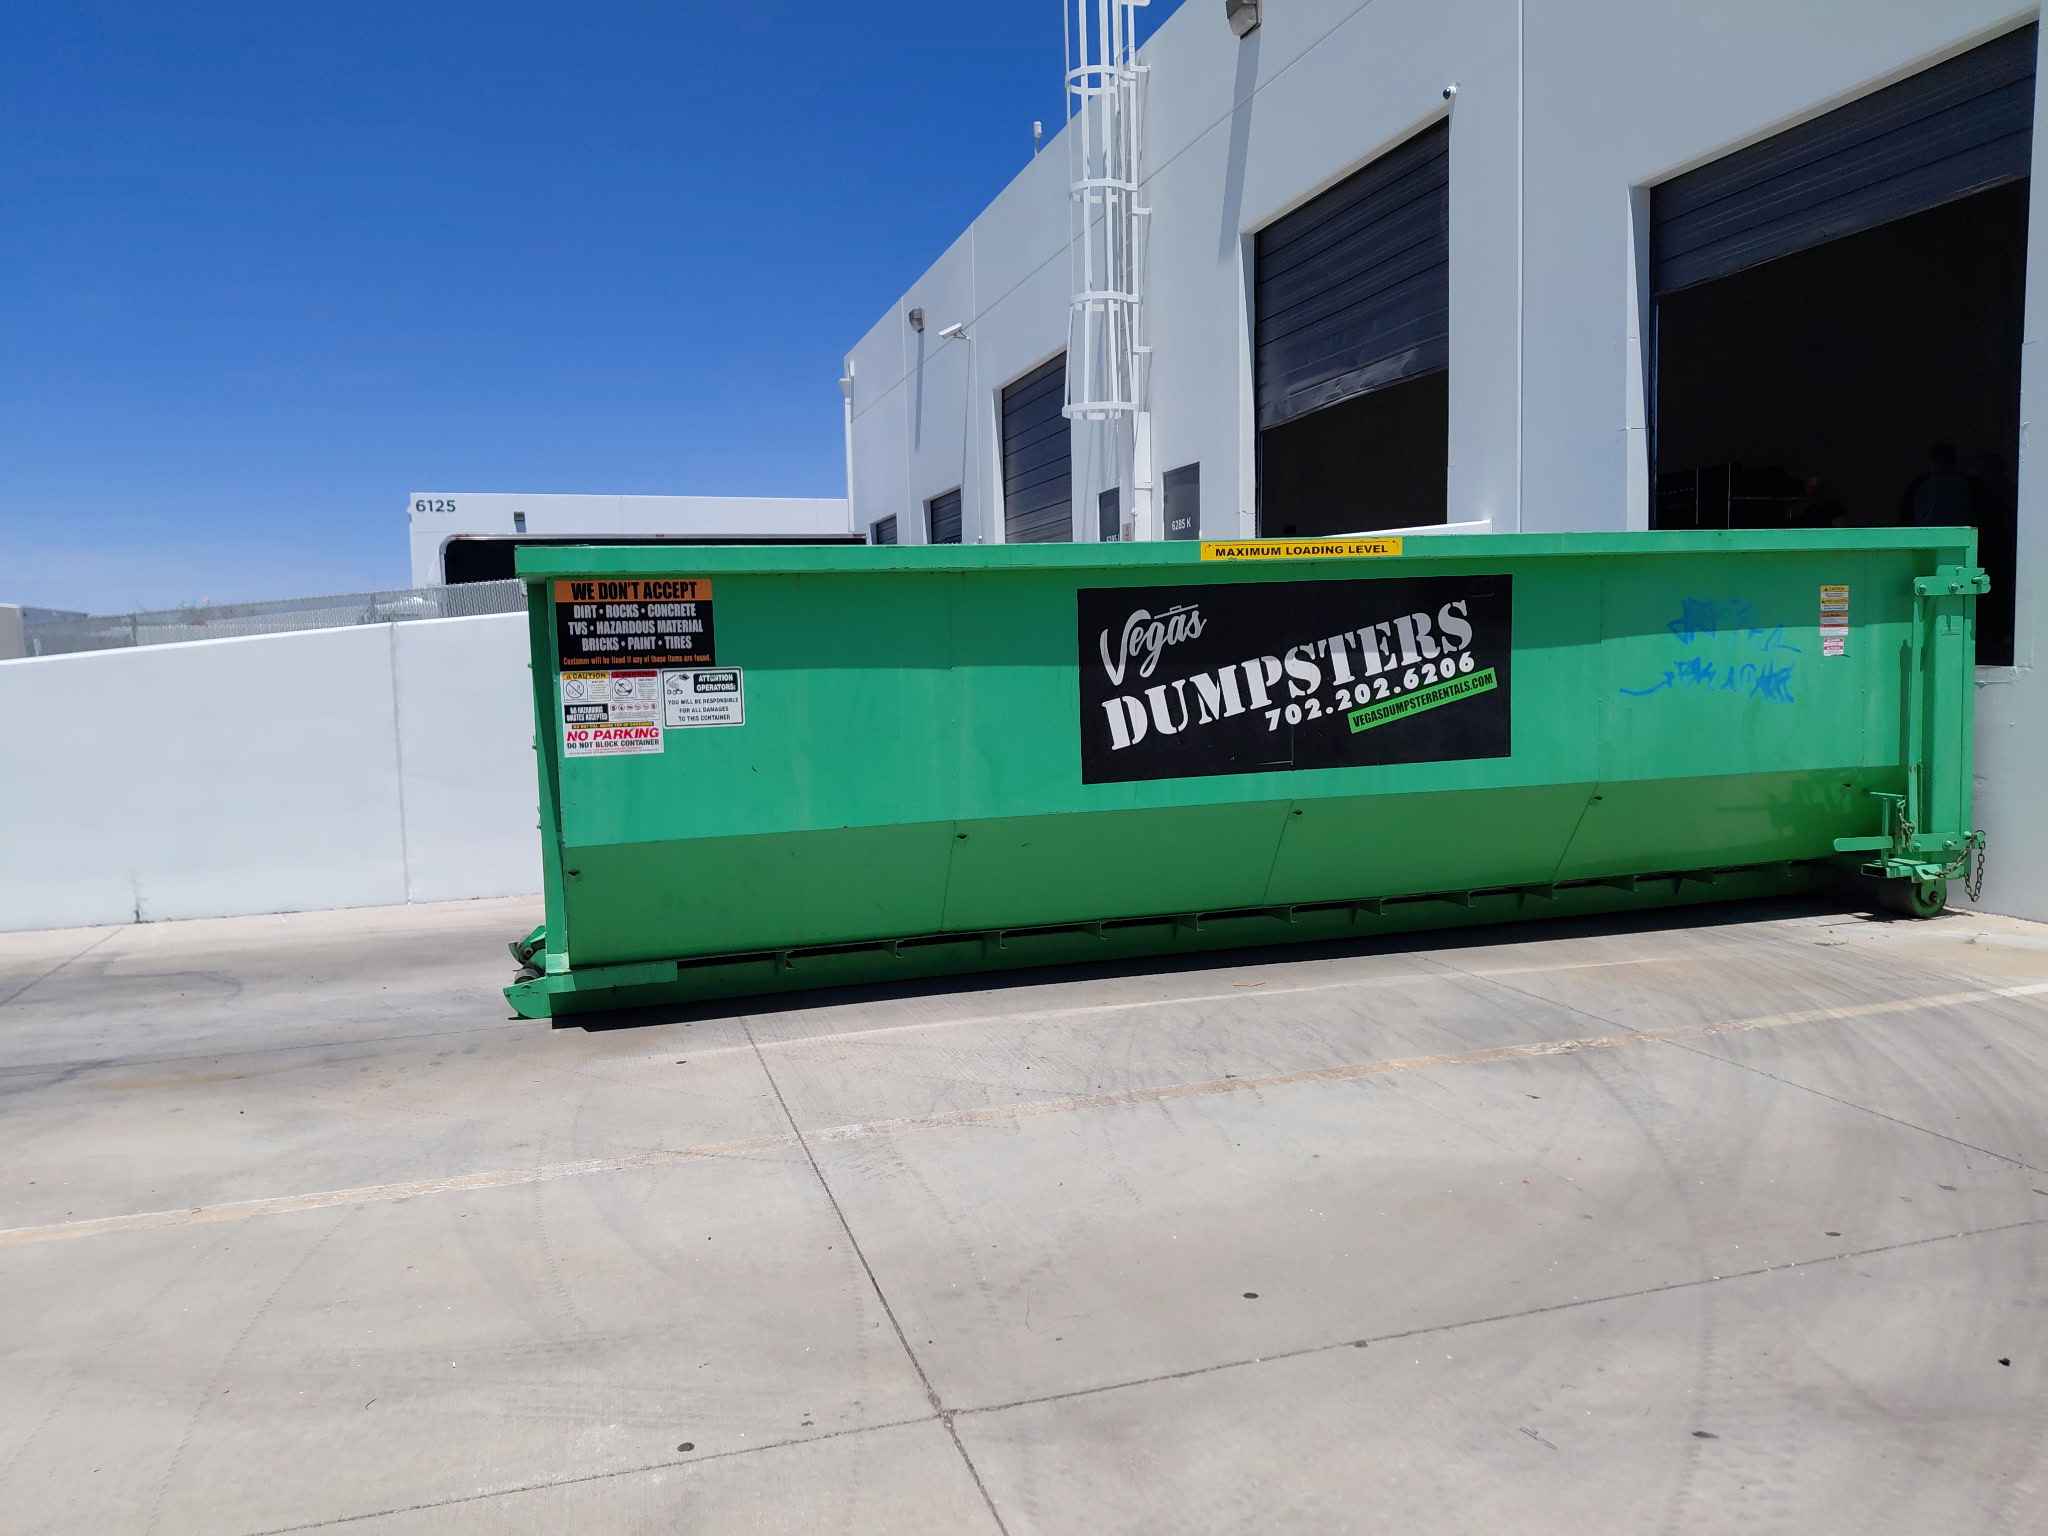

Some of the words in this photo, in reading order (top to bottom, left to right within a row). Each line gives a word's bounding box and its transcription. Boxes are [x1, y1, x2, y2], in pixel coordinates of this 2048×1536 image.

[416, 500, 456, 512] 6125
[1172, 519, 1185, 531] 6285
[1186, 517, 1192, 528] K
[1215, 547, 1281, 557] MAXIMUM
[1285, 546, 1345, 555] LOADING
[1348, 544, 1388, 554] LEVEL
[571, 582, 595, 600] WE
[598, 582, 639, 600] DON'T
[643, 581, 697, 599] ACCEPT
[574, 605, 597, 619] DIRT
[606, 604, 639, 618] ROCKS
[647, 603, 696, 617] CONCRETE
[568, 622, 588, 635] TVS
[597, 620, 655, 635] HAZARDOUS
[657, 619, 703, 633] MATERIAL
[582, 637, 619, 651] BRICKS
[628, 637, 656, 650] PAINT
[664, 636, 692, 649] TIRES
[1100, 608, 1207, 686] Vegas
[564, 657, 589, 665] Customer
[591, 656, 601, 664] will
[603, 656, 609, 664] be
[644, 655, 649, 663] of
[651, 655, 666, 663] these
[694, 654, 711, 662] found.
[699, 674, 733, 682] ATTENTION
[1101, 600, 1473, 751] DUMPSTERS
[697, 683, 736, 691] OPERATORS:
[1264, 651, 1475, 731] 702.202.6206
[1352, 672, 1495, 728] VEGASDUMPSTERRENTALS.COM
[567, 731, 589, 741] NO
[593, 727, 659, 740] PARKING
[596, 740, 618, 748] BLOCK
